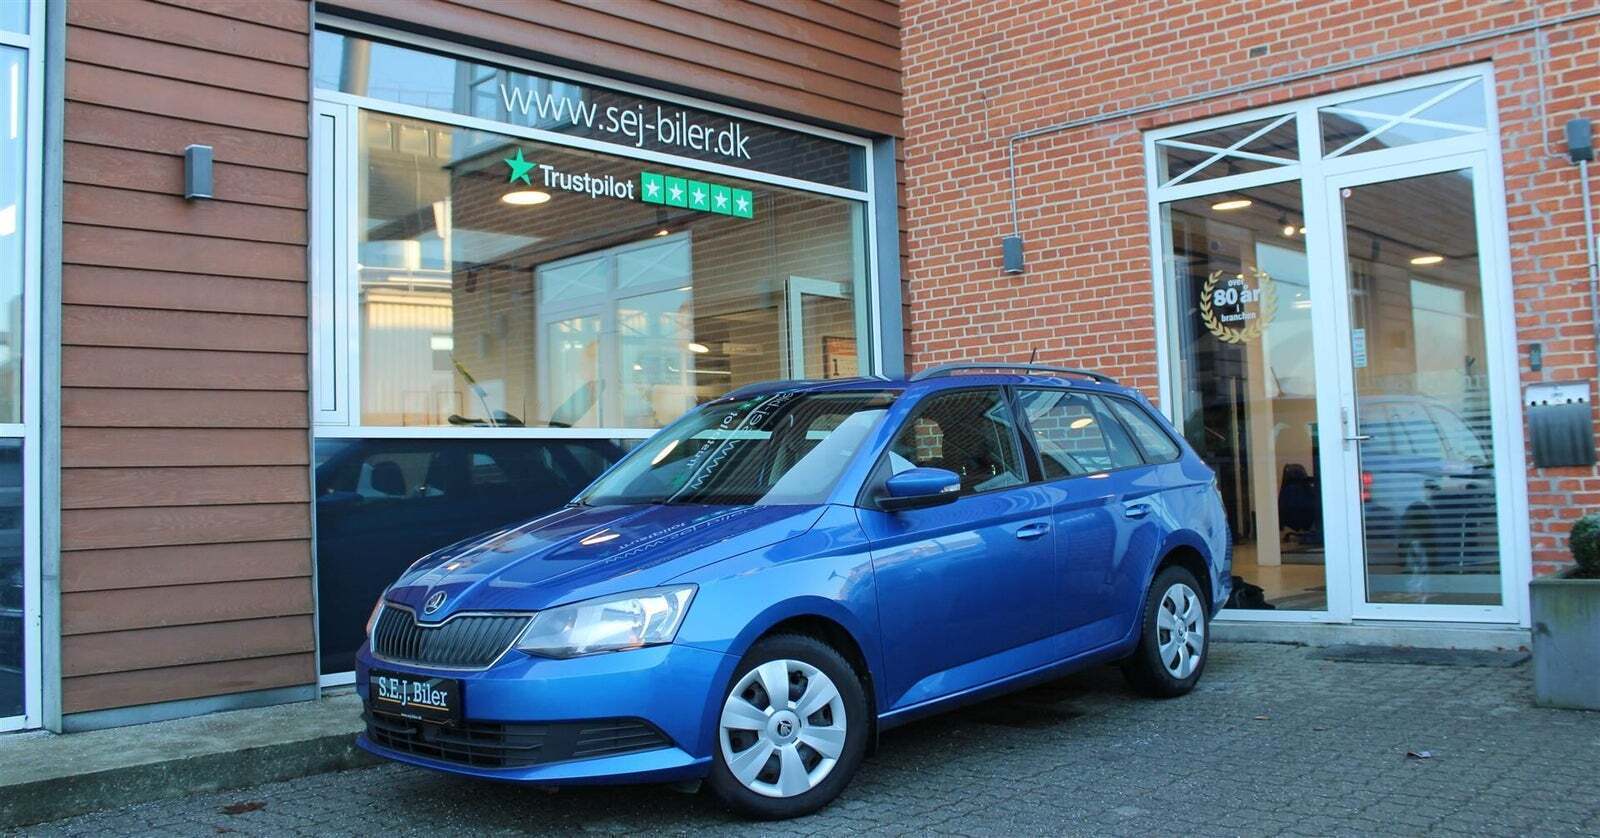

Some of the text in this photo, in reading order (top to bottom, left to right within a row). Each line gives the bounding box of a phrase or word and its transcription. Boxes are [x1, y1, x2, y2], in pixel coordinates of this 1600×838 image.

[500, 84, 751, 159] www.sej-biler.dk
[539, 164, 634, 199] Trustpilot
[1213, 284, 1260, 307] 80 år
[1221, 311, 1257, 322] branchen
[378, 676, 448, 707] S.E.J. Biler
